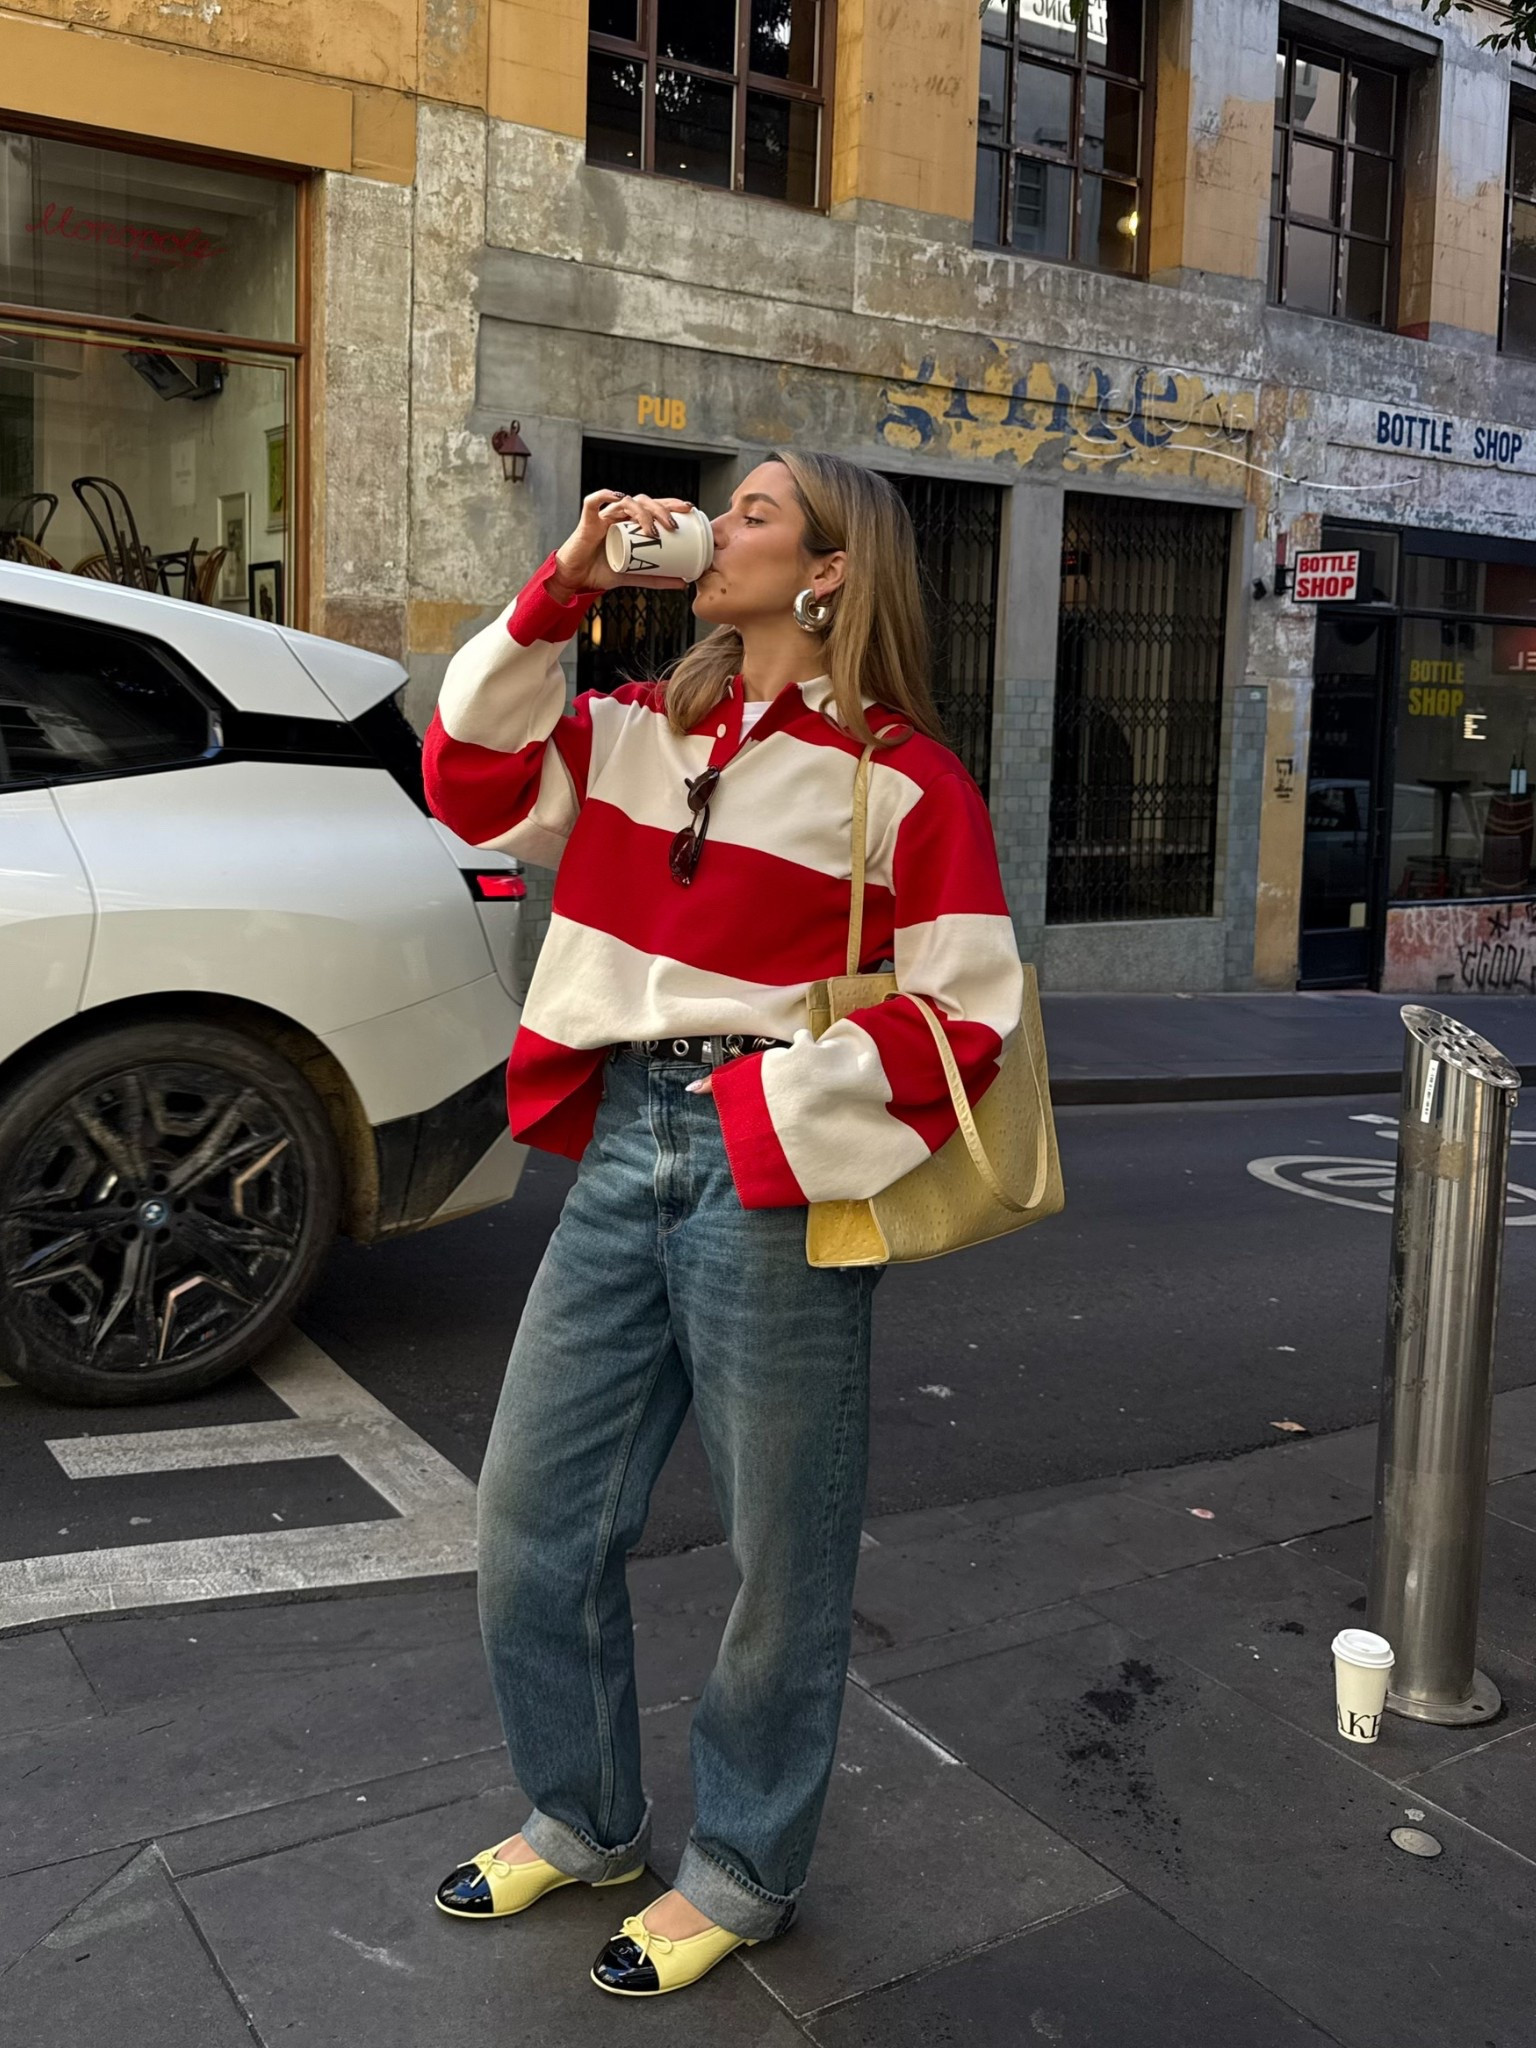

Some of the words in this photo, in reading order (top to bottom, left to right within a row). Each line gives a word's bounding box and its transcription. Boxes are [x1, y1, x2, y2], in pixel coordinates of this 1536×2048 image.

[638, 395, 686, 430] PUB
[1376, 411, 1454, 454] BOTTLE
[1473, 427, 1523, 464] SHOP
[1298, 556, 1357, 573] BOTTLE
[1296, 576, 1355, 598] SHOP
[1409, 660, 1465, 684] BOTTLE
[1408, 688, 1465, 716] SHOP
